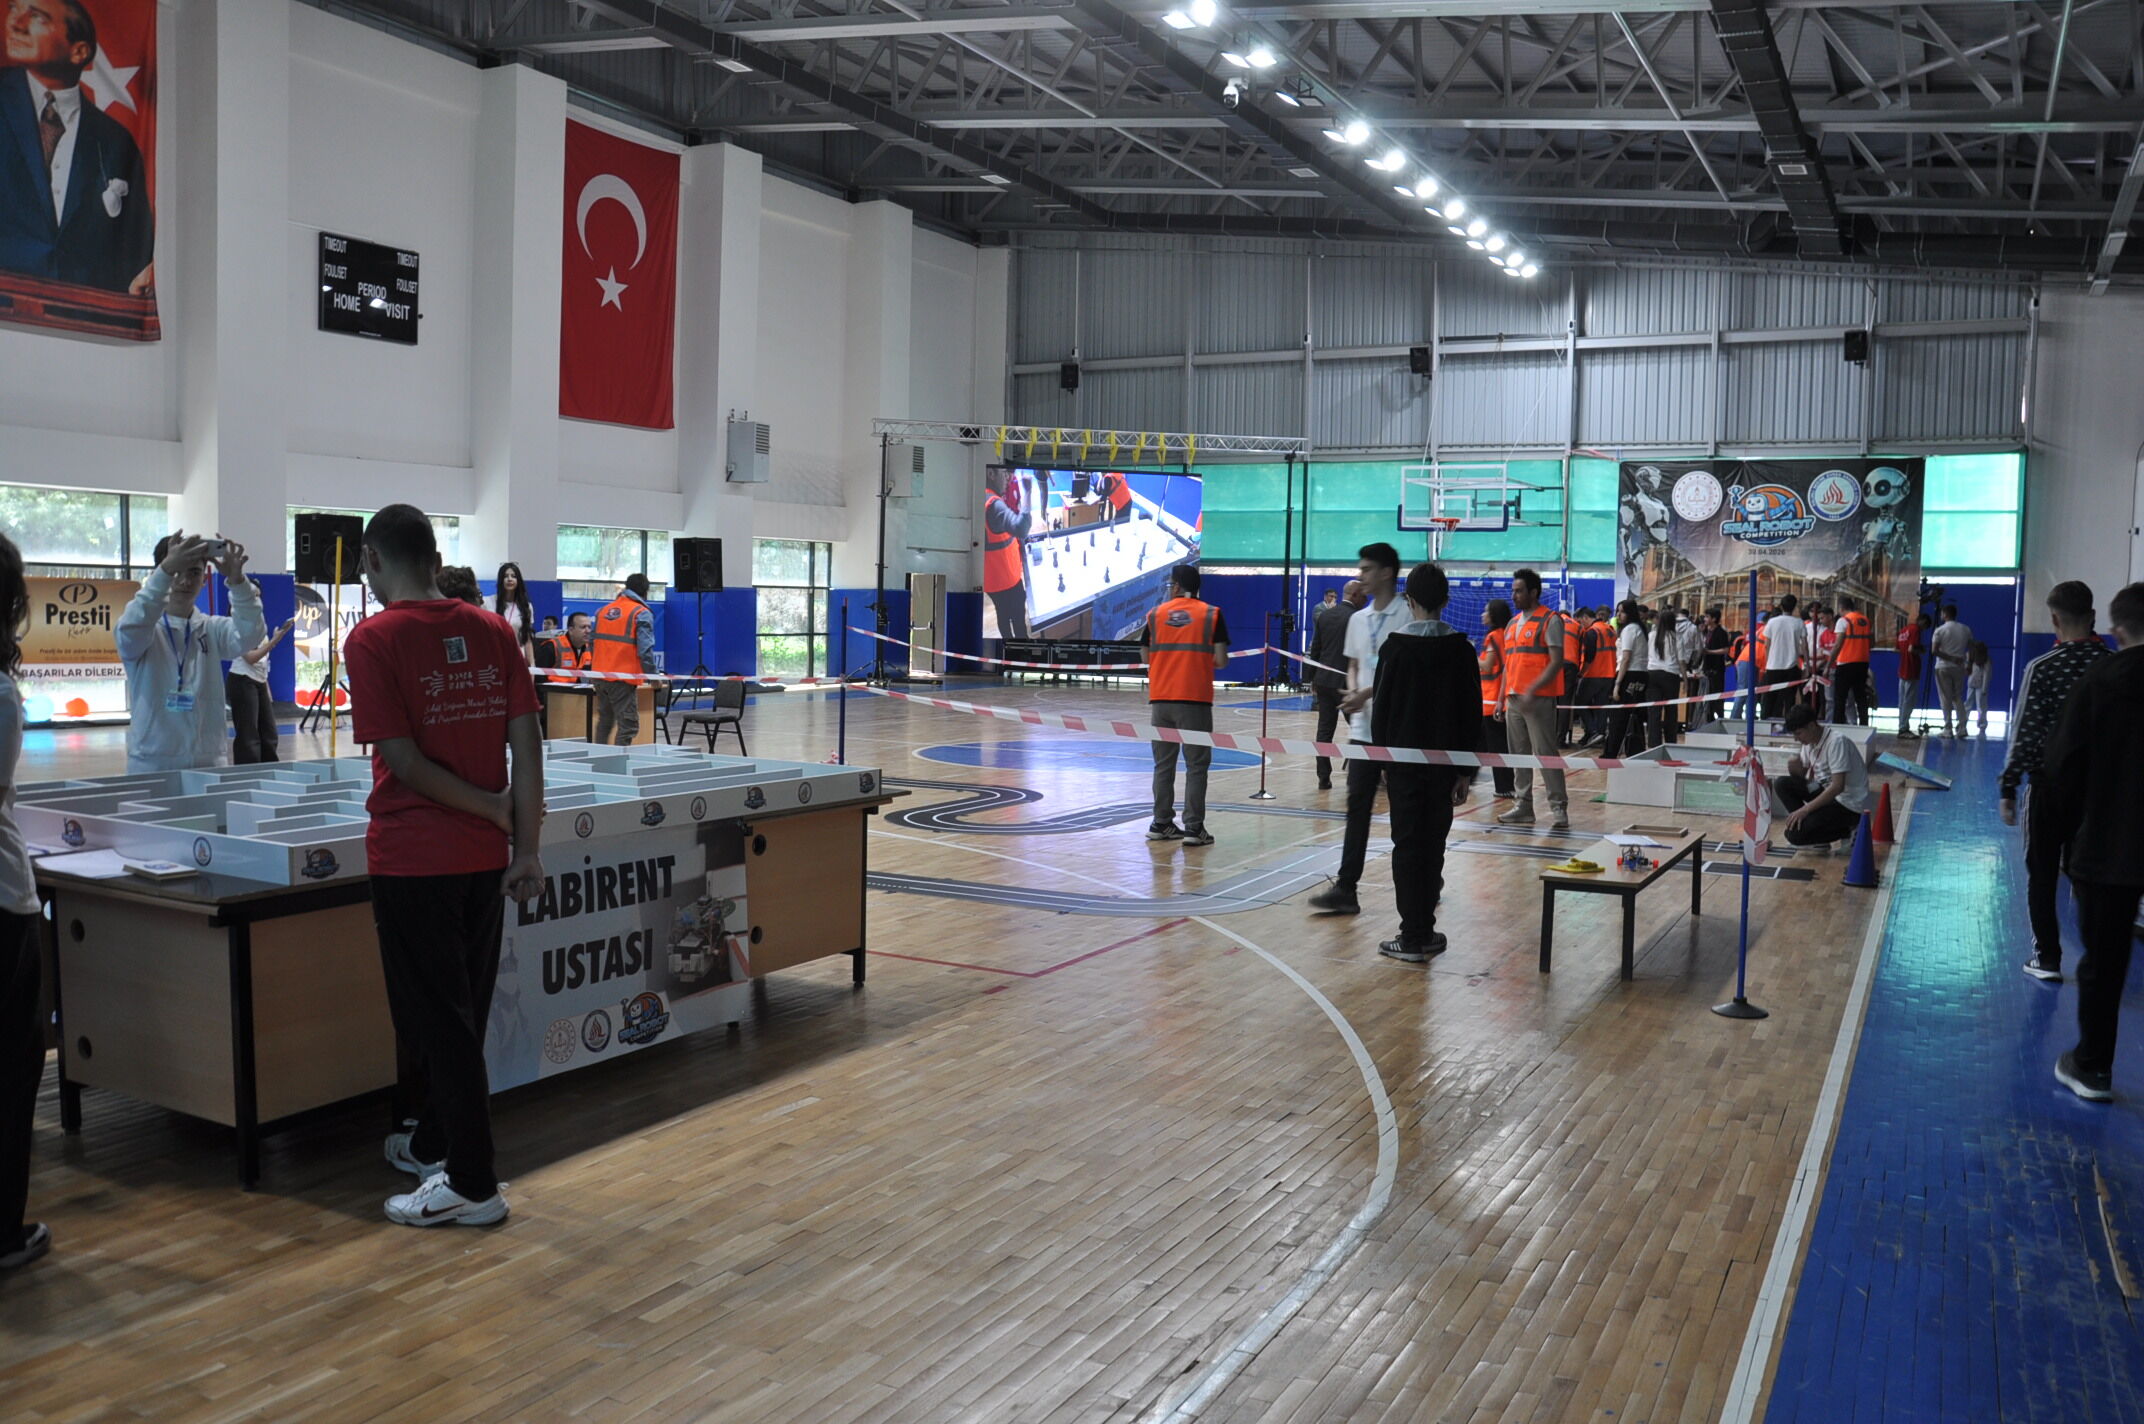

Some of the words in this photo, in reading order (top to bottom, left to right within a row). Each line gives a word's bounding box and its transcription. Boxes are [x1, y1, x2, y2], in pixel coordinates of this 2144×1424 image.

[324, 236, 348, 254] TIMEOUT
[397, 252, 418, 269] TIMEOUT
[357, 282, 388, 299] PERIOD
[333, 292, 361, 312] HOME
[385, 302, 411, 321] VISIT
[1723, 521, 1758, 534] SEAL
[1760, 518, 1814, 531] ROBOT
[1740, 530, 1800, 539] COMPETITION
[45, 602, 111, 631] Prestij
[542, 928, 653, 995] USTASI
